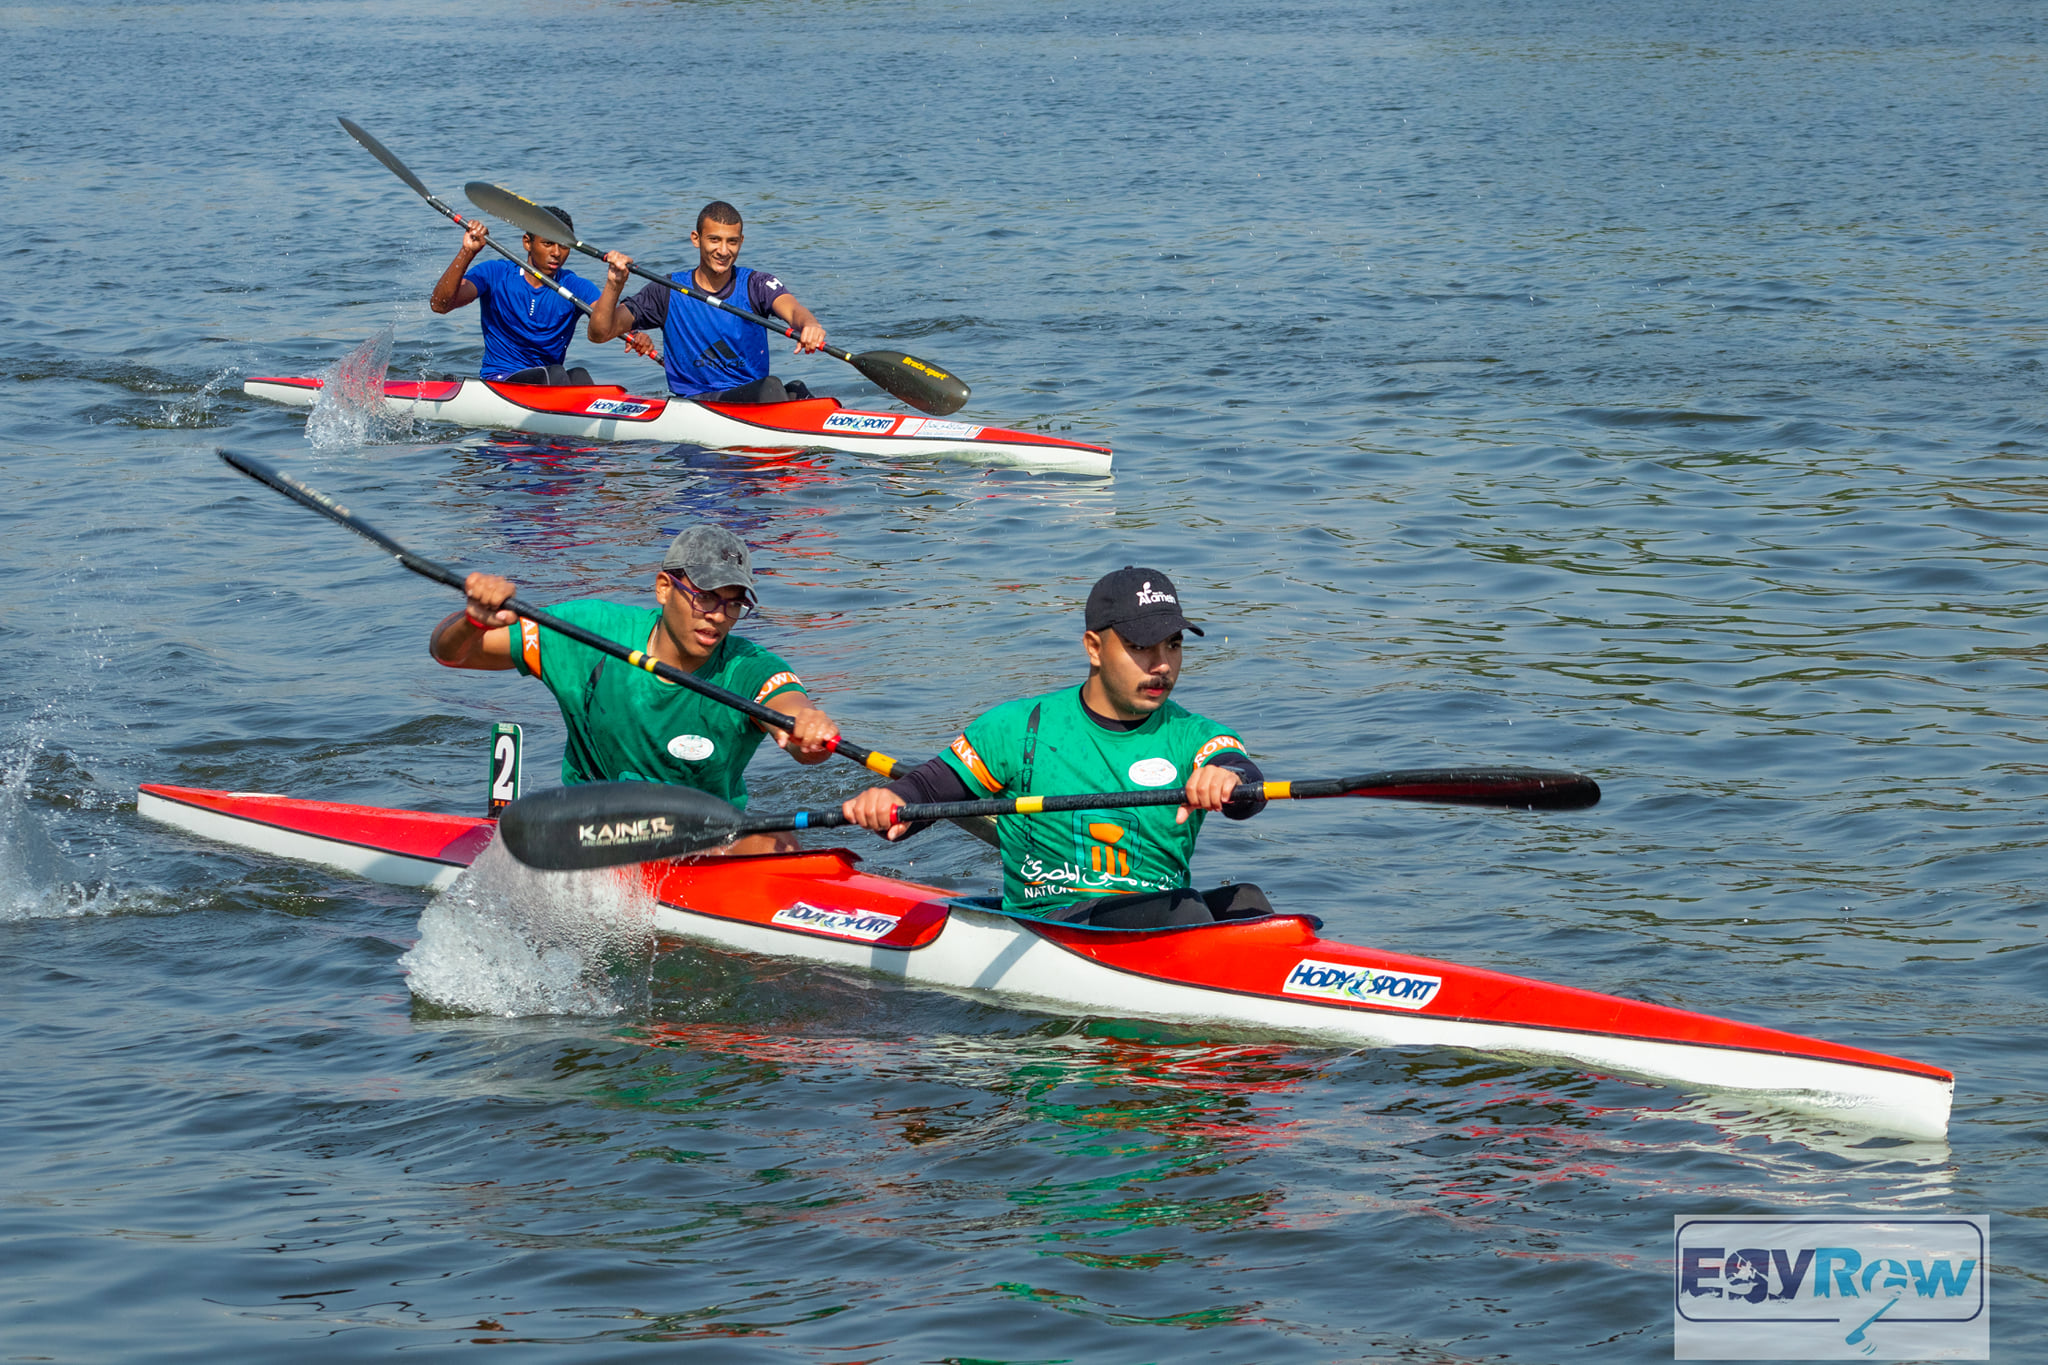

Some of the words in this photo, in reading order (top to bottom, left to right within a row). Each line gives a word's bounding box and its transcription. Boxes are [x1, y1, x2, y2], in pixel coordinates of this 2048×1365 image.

[861, 418, 894, 430] SPORT
[492, 735, 515, 801] 2
[579, 817, 674, 841] KAINER
[1366, 974, 1439, 1001] SPORT
